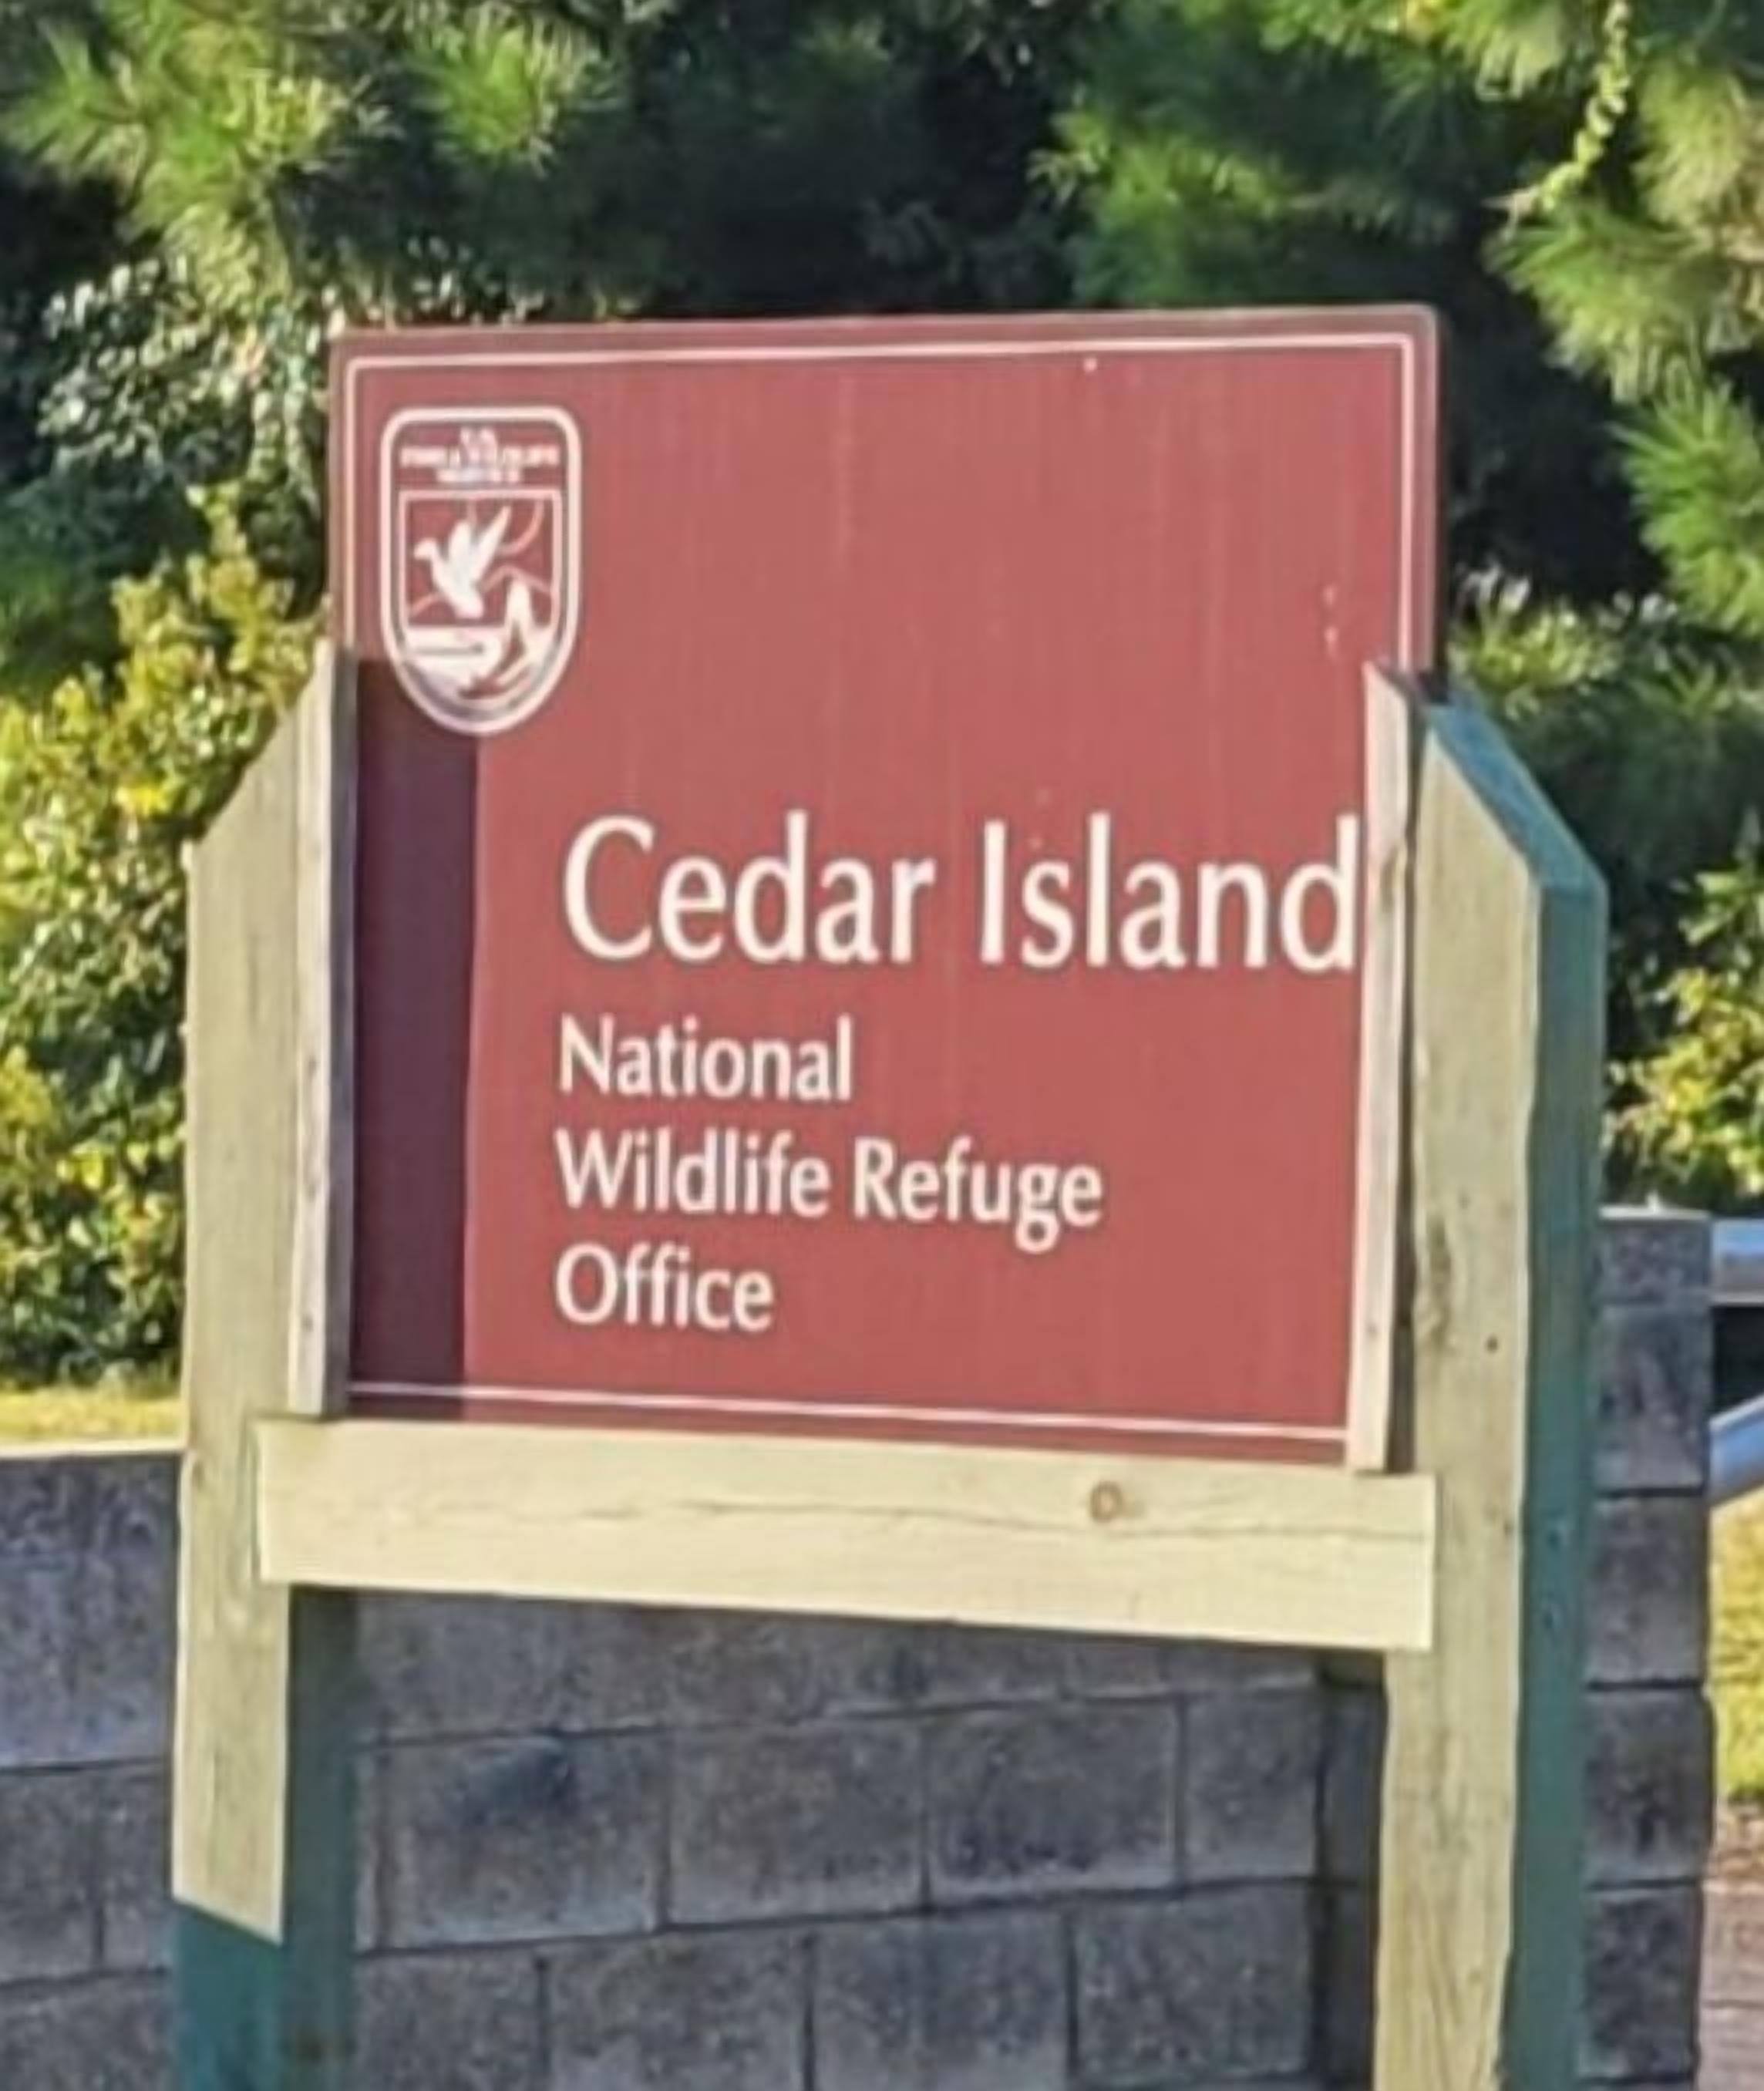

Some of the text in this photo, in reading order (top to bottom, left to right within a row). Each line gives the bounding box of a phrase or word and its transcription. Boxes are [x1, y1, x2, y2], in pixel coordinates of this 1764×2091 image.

[564, 809, 1359, 971] Cedar Island
[560, 1015, 852, 1099] National
[554, 1127, 1103, 1253] Wildlife Refuge
[555, 1242, 773, 1332] Office
